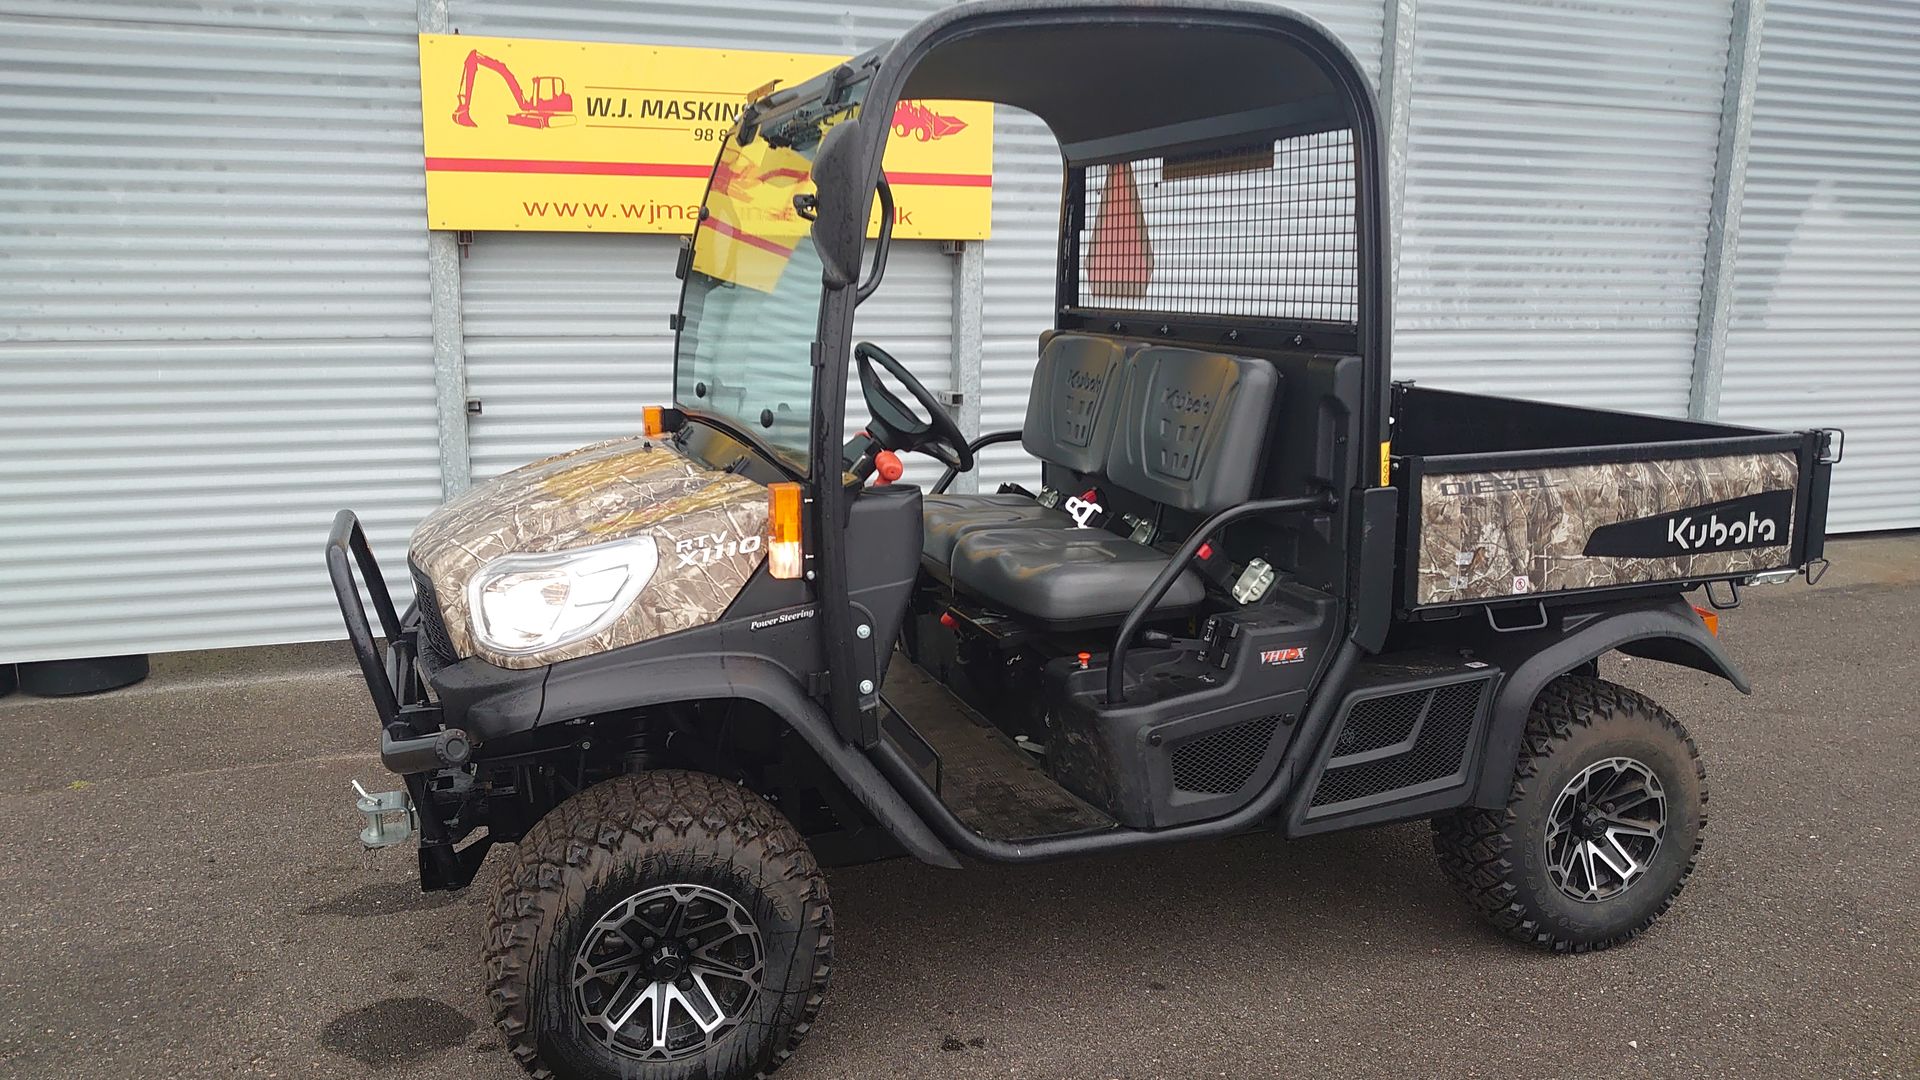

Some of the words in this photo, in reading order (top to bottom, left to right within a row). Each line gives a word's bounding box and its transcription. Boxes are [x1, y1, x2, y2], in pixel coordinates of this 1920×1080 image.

[586, 97, 633, 118] W.J.
[640, 99, 746, 122] MASKIN
[694, 127, 714, 141] 98
[1440, 476, 1560, 496] DIESEL
[1667, 511, 1776, 549] Kubota
[675, 531, 728, 553] RTV
[675, 536, 761, 569] X1110
[750, 618, 779, 630] Power
[778, 609, 815, 624] Steering
